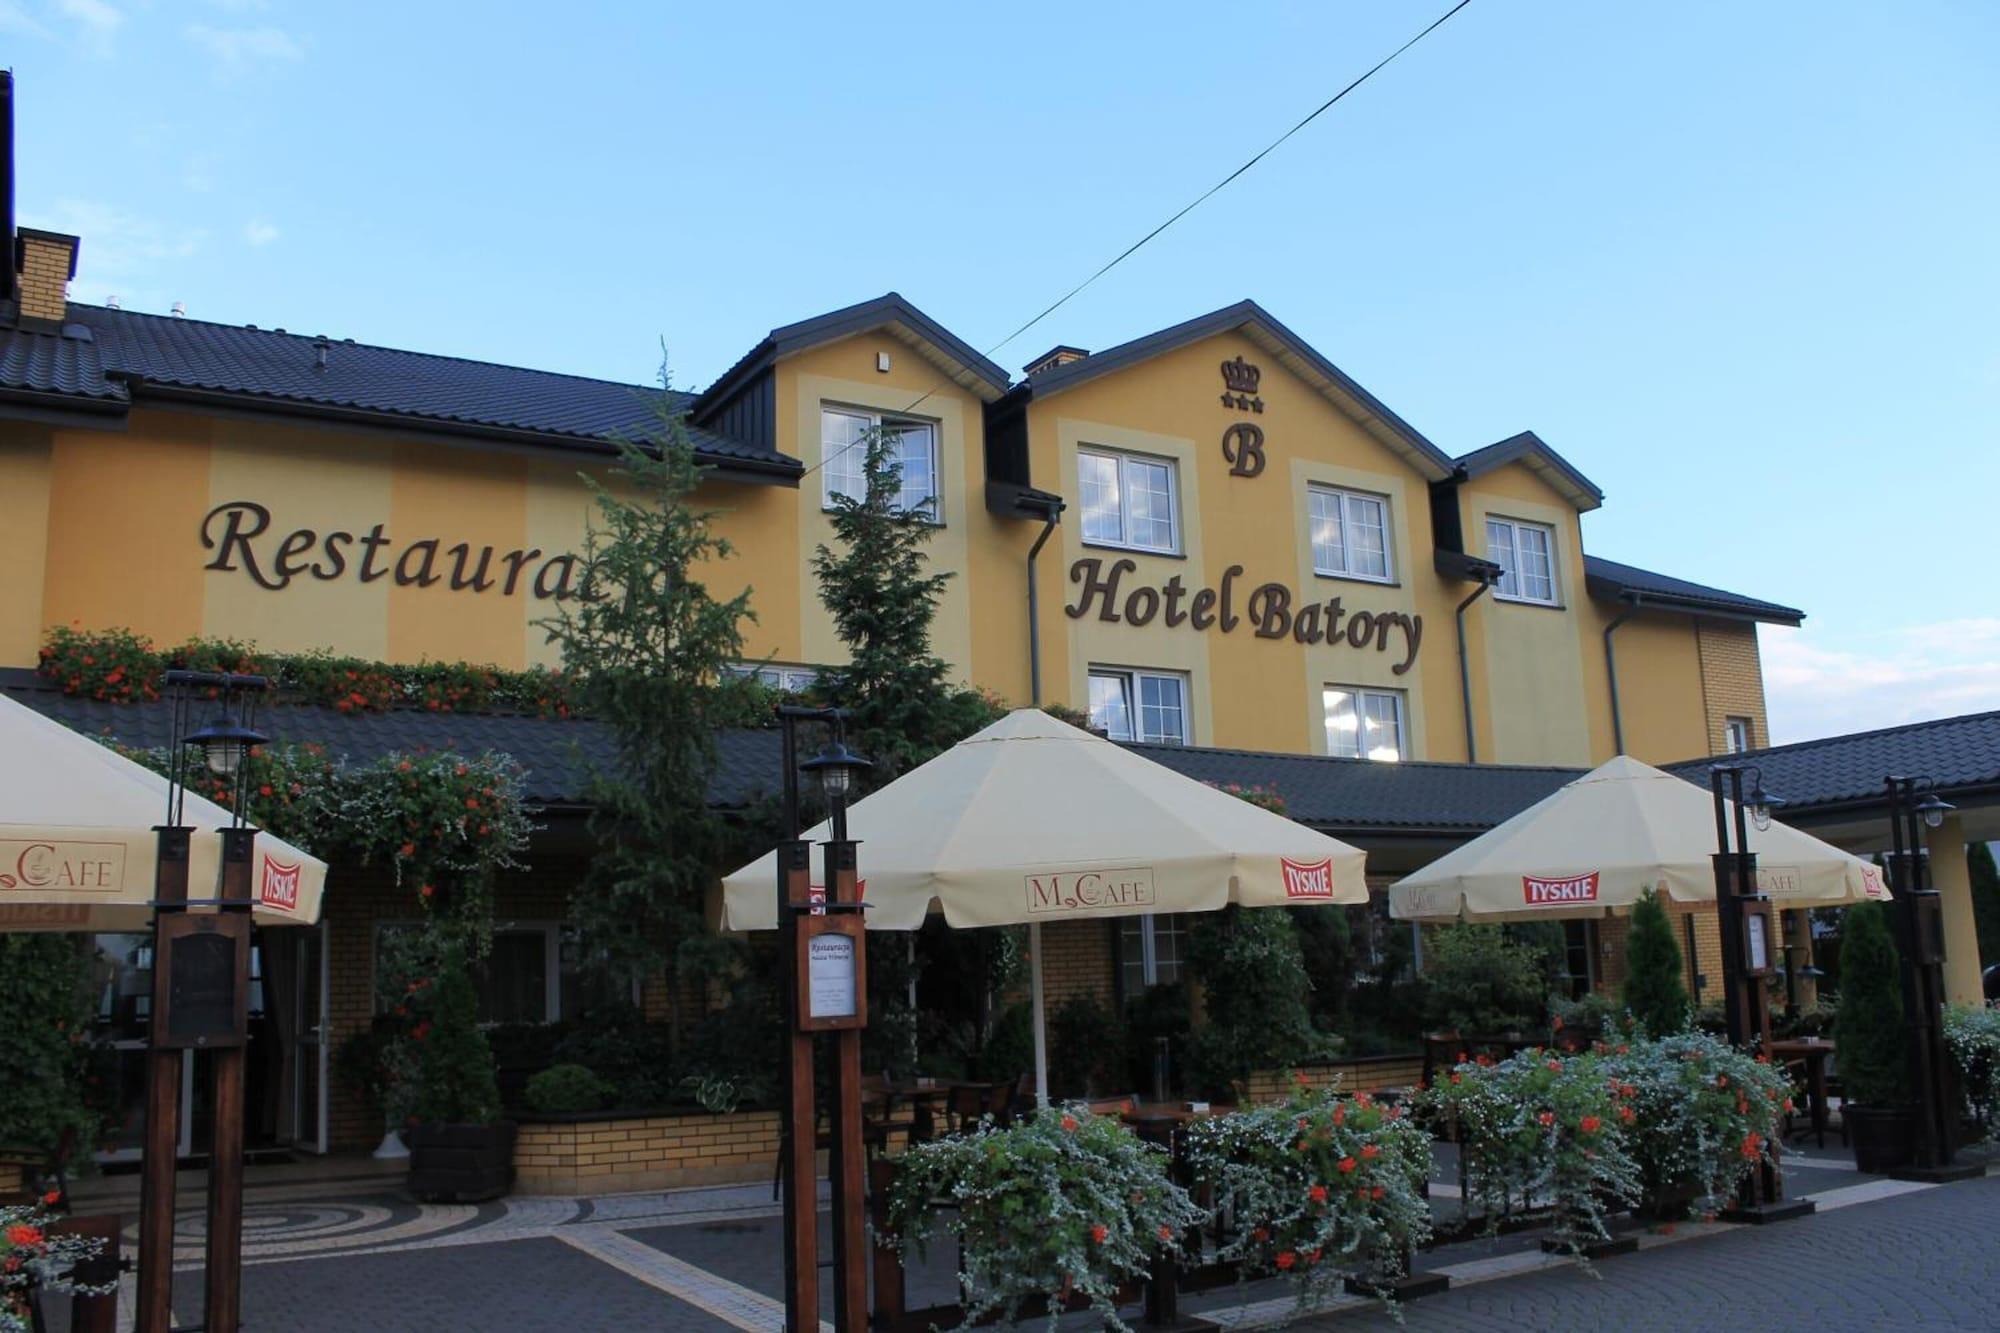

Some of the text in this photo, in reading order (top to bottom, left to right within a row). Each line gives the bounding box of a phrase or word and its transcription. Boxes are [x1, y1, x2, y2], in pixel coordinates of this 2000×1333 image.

[1223, 423, 1266, 479] B
[1065, 558, 1422, 675] Hotel Batory
[265, 864, 297, 903] TYSKIE
[1286, 866, 1330, 893] TYSKIE
[1528, 878, 1594, 901] TYSKIE
